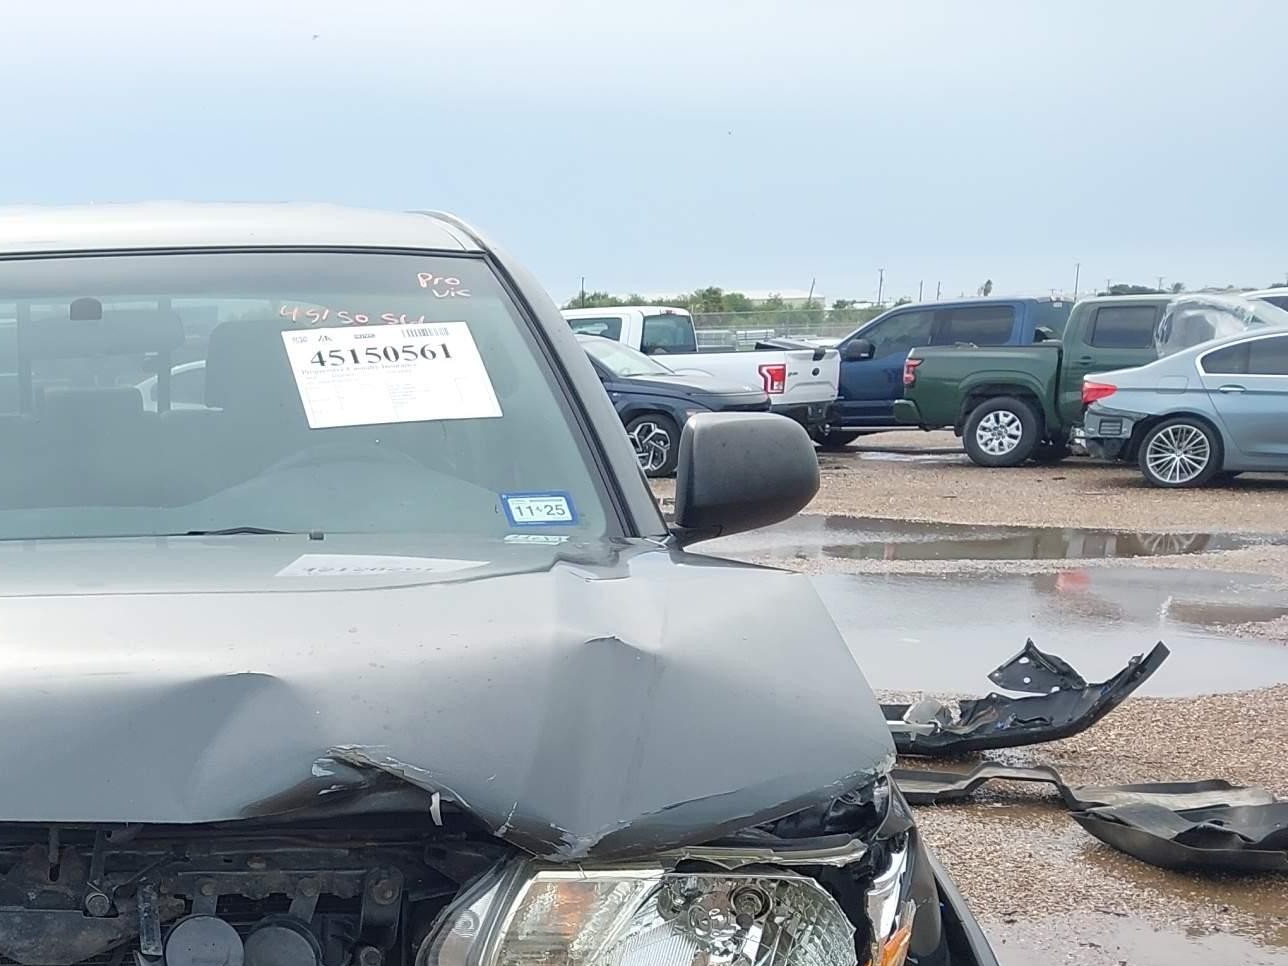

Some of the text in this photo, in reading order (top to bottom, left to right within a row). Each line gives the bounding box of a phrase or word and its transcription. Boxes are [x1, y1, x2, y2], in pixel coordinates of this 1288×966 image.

[416, 272, 461, 288] Pro
[310, 342, 453, 367] 45150561
[515, 504, 566, 517] 11 25
